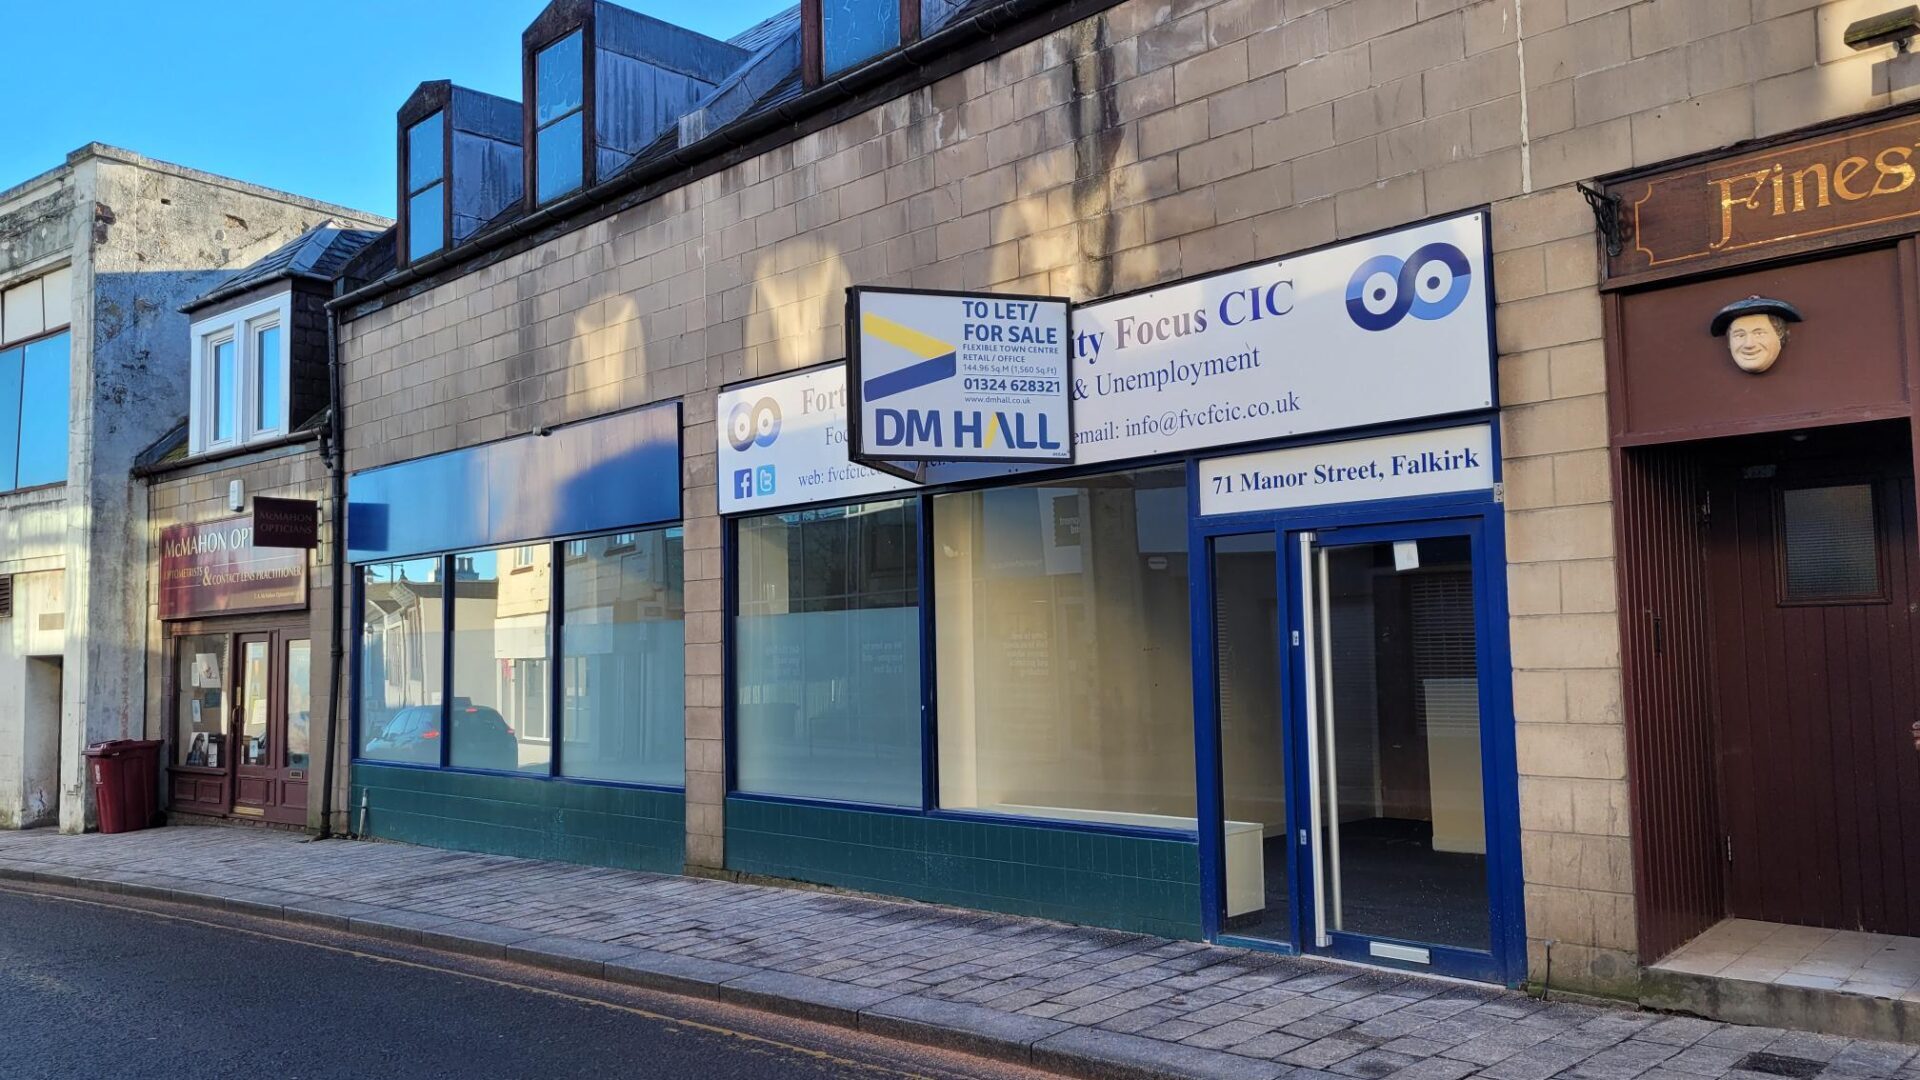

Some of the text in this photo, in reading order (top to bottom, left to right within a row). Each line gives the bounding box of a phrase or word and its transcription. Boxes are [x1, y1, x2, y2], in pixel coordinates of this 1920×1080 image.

[1707, 138, 1920, 249] Fines
[962, 300, 1038, 323] TO LET/
[1113, 307, 1208, 351] Focus
[1219, 278, 1294, 327] CIC
[964, 323, 1057, 345] FOR SALE
[962, 343, 1059, 354] FLEXIBLE TOWN CENTRE
[963, 353, 990, 362] RETAIL
[997, 354, 1026, 363] OFFICE
[963, 364, 990, 372] 144.96
[1072, 378, 1089, 401] &
[1096, 347, 1261, 396] Unemployment
[964, 377, 1060, 393] 01324 628321
[964, 396, 1031, 405] www.dmhall.co.uk
[798, 469, 824, 487] web:
[1073, 421, 1119, 446] email:
[1125, 391, 1301, 437] info@fvcfcic.co.uk
[875, 408, 1061, 450] DM HALL
[1212, 448, 1480, 495] 71 Manor Street, Falkirk
[260, 523, 313, 535] OPTICIANS
[164, 566, 203, 580] OPTOMETRISTS
[202, 565, 213, 587] &
[212, 572, 240, 585] CONTACT
[240, 570, 255, 582] LENS
